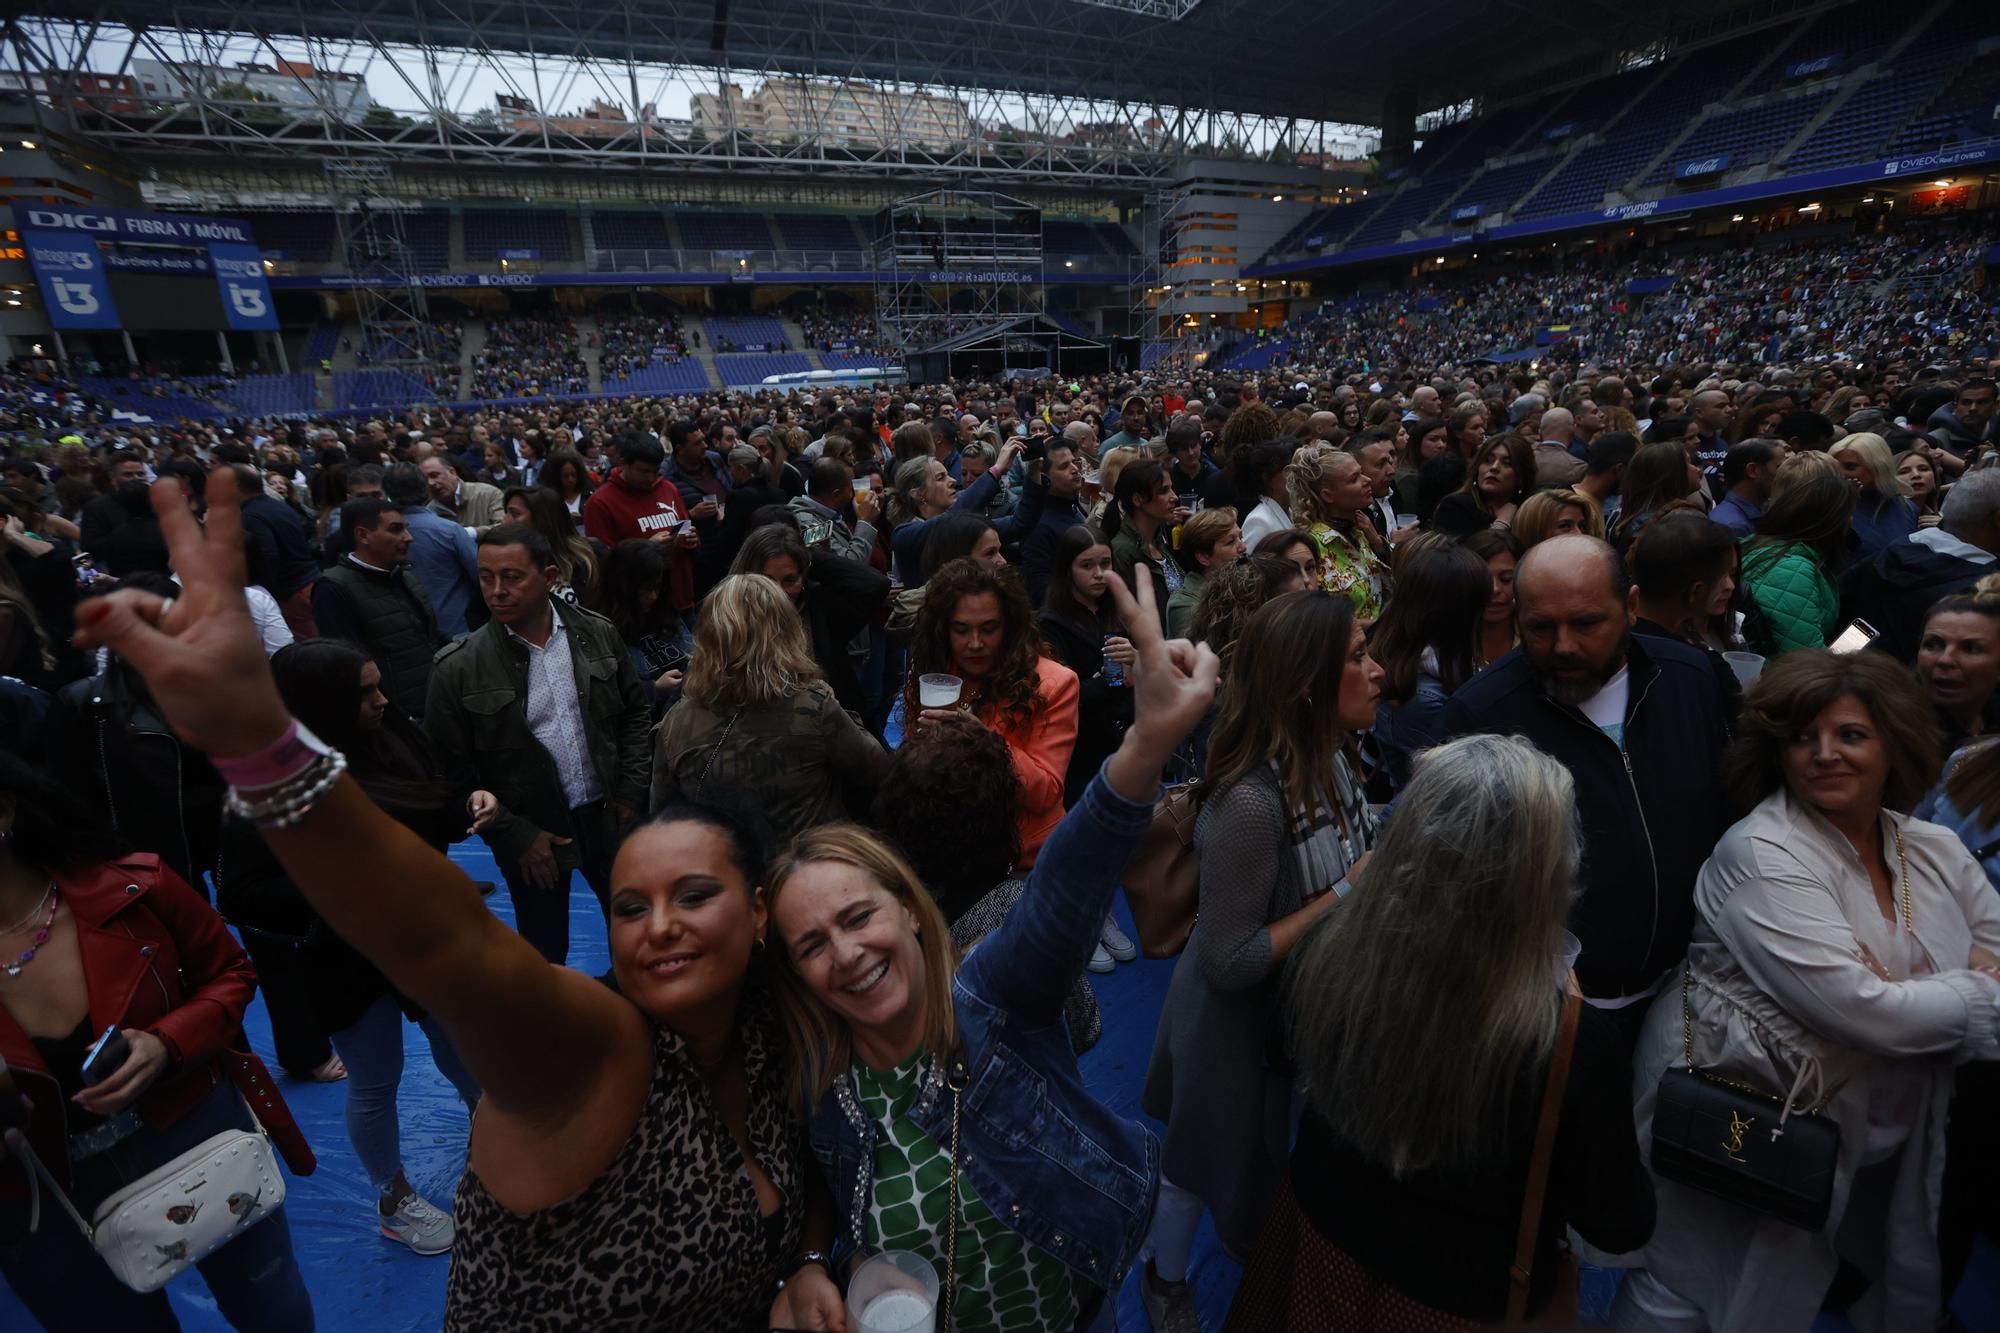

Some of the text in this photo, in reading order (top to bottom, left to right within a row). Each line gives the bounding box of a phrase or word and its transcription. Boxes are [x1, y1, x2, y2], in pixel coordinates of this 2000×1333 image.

[1619, 200, 1659, 215] HYUNDAI
[28, 210, 249, 242] DIGI FIBRA Y MÓVIL
[421, 275, 466, 285] OVIEDO
[489, 275, 532, 285] OVIEDO
[637, 511, 678, 533] PUMA
